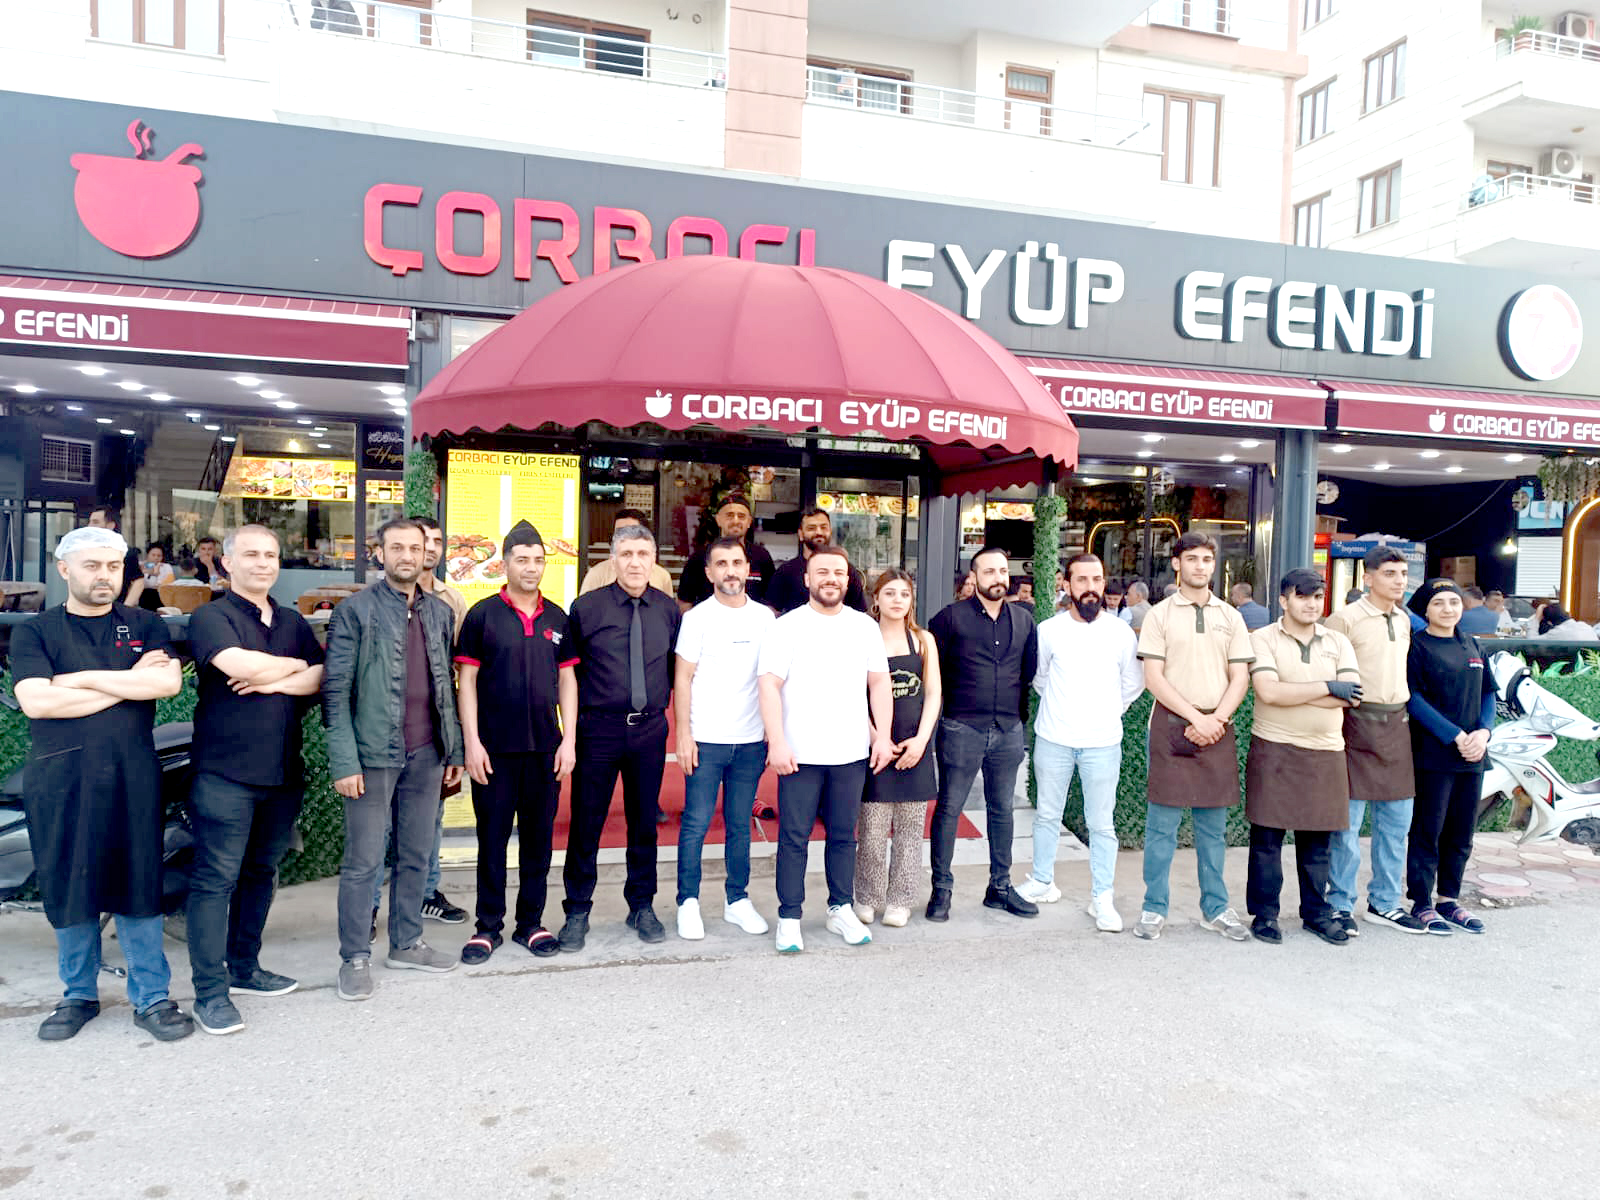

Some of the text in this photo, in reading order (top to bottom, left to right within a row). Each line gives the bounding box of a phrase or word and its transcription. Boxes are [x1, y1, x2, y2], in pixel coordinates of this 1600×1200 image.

[885, 239, 1125, 329] EYÜP
[682, 394, 822, 423] ÇORBACI
[840, 400, 920, 428] EYÜP
[1061, 386, 1146, 411] ÇORBACI
[1151, 390, 1203, 416] EYÜP
[1453, 414, 1523, 436] ÇORBACI
[1526, 417, 1569, 439] EYÜP
[503, 453, 537, 466] EYÜP
